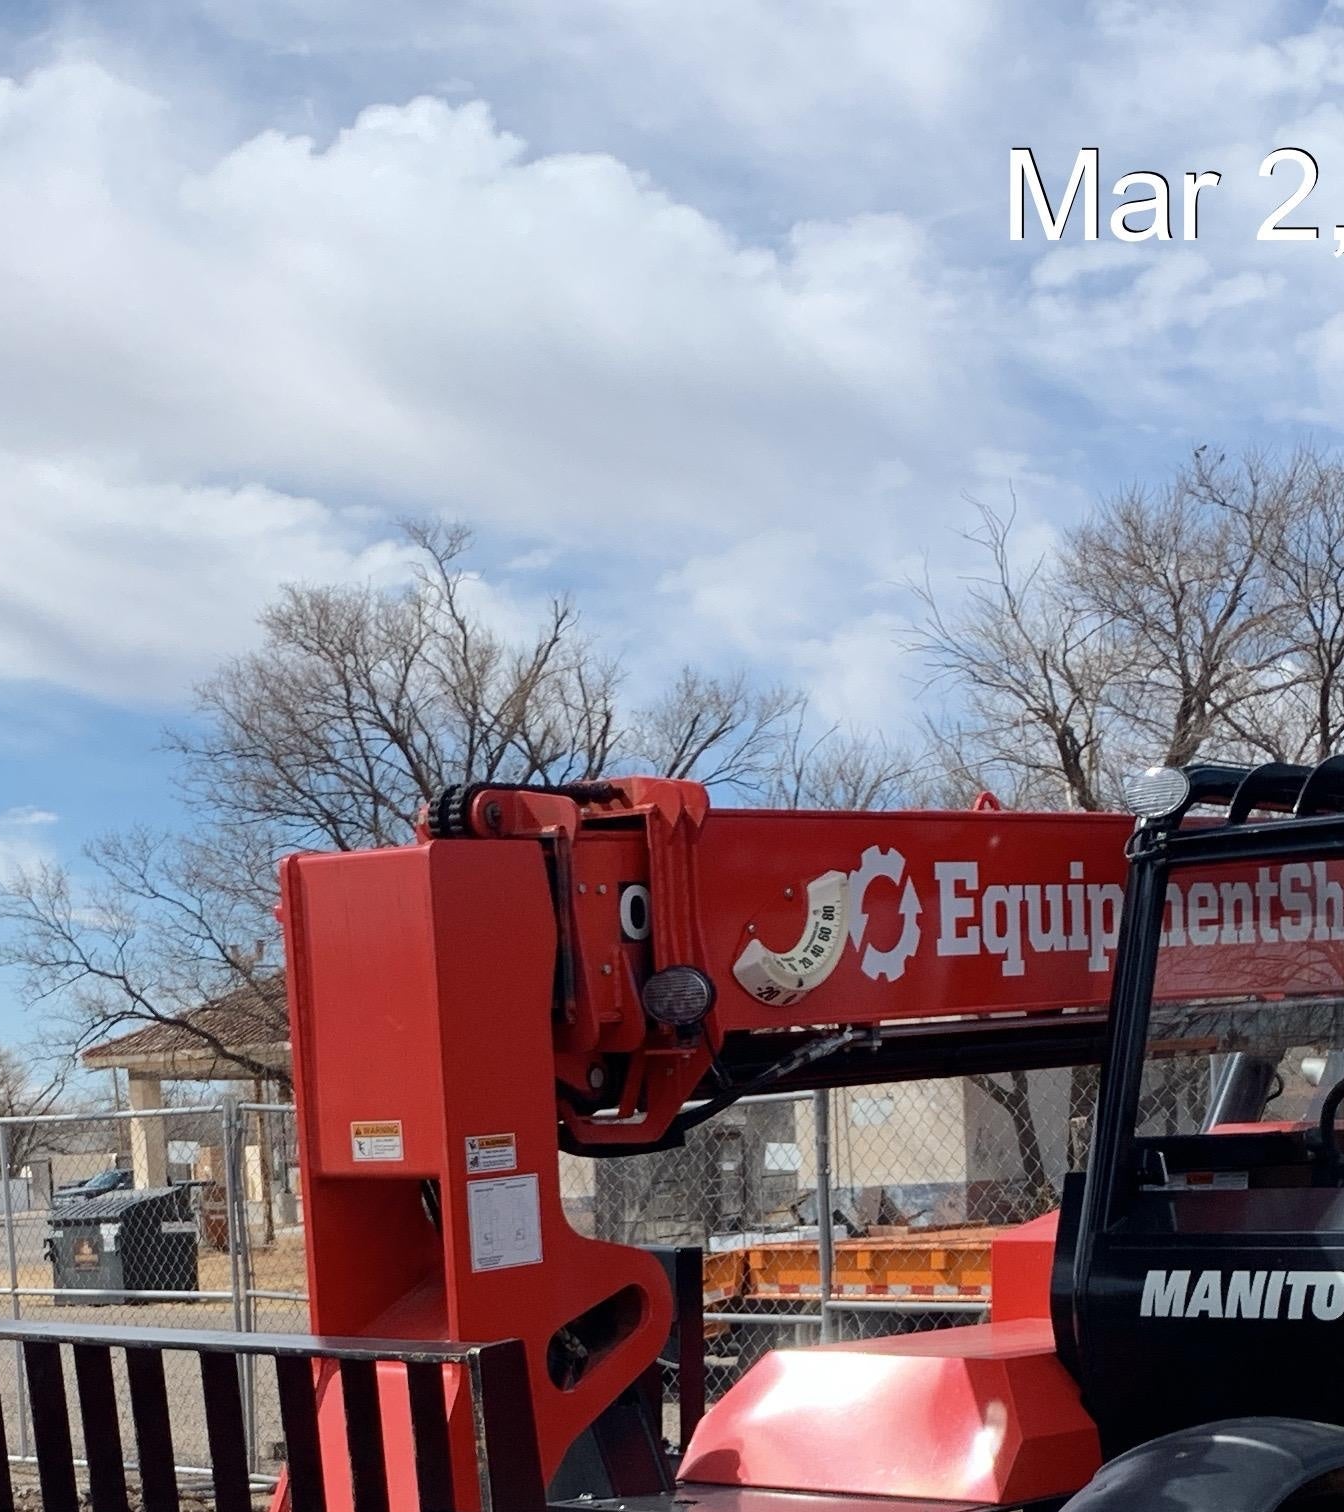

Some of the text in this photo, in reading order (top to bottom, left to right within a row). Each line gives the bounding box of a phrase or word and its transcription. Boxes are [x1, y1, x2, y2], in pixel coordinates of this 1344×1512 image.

[822, 905, 835, 921] 80
[818, 926, 832, 942] 60
[810, 944, 824, 958] 40
[798, 957, 814, 969] 20
